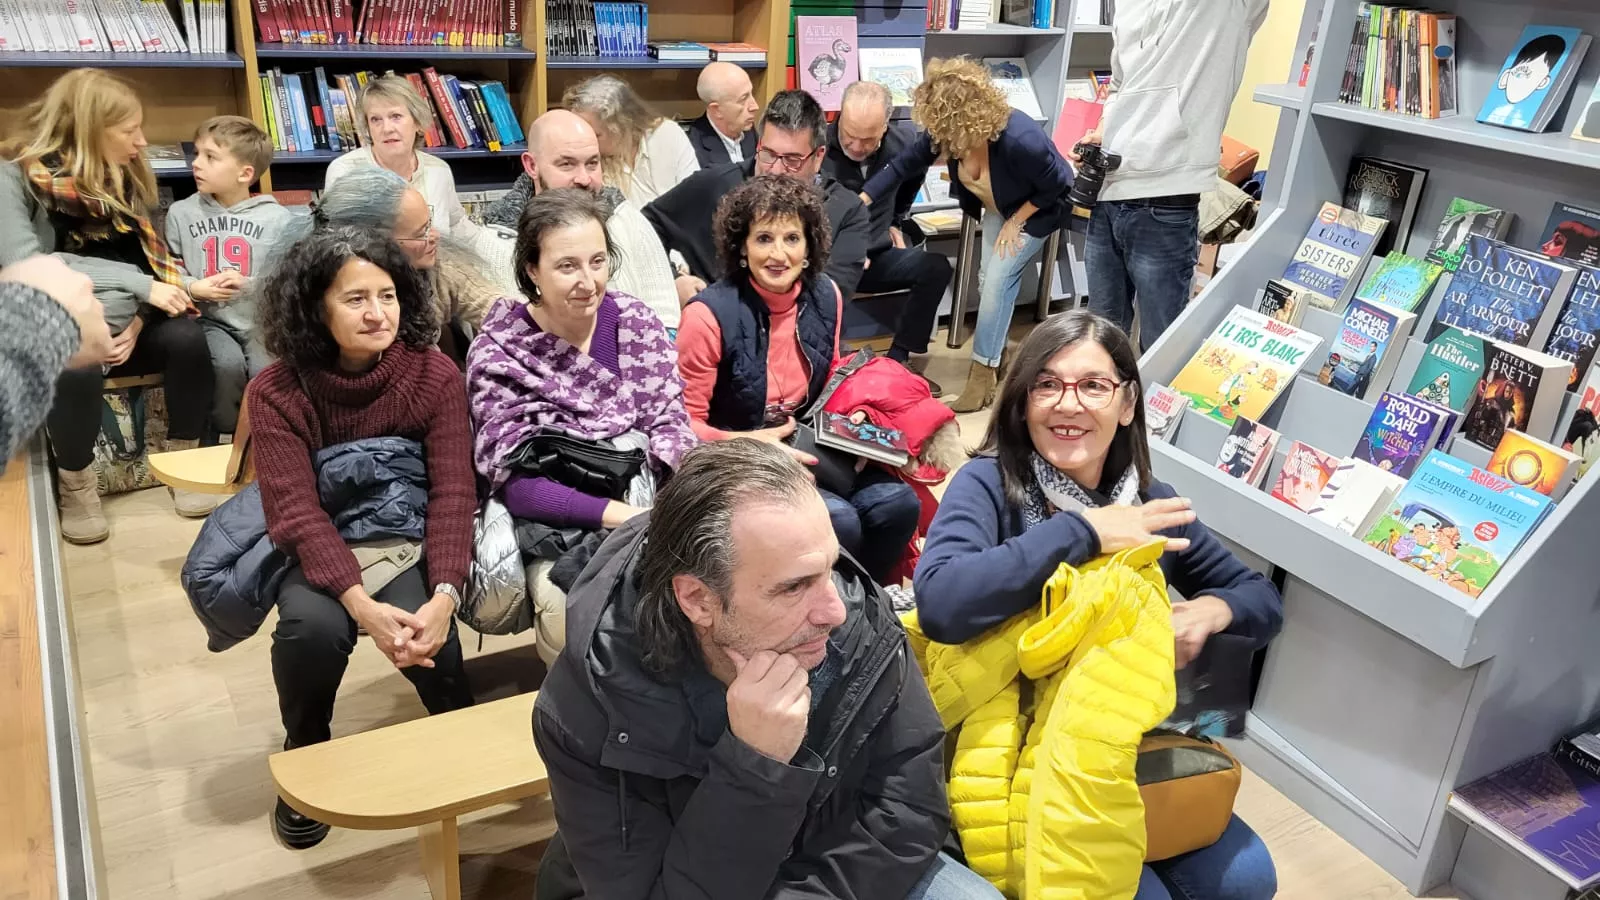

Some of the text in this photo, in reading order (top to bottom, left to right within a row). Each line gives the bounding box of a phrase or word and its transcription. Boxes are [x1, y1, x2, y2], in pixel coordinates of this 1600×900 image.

[805, 25, 844, 37] ATLAS
[1358, 162, 1399, 187] PATRICK
[189, 216, 264, 240] CHAMPION
[1318, 226, 1360, 250] three
[202, 236, 254, 279] 19
[1301, 244, 1353, 273] SISTERS
[1504, 257, 1539, 280] KEN
[1298, 274, 1328, 291] MORRIS
[1300, 268, 1333, 285] HEATHER
[1480, 266, 1551, 303] FOLLETT
[1577, 271, 1600, 290] EN
[1490, 296, 1515, 314] The
[1345, 316, 1390, 343] CONNELLY
[1351, 307, 1389, 331] MICHAEL
[1466, 303, 1530, 336] ARMOUR
[1260, 338, 1306, 365] BLANC
[1430, 343, 1480, 372] Hustler
[1446, 342, 1463, 356] The
[1500, 351, 1525, 369] PETER
[1490, 358, 1538, 387] BRETT
[1386, 397, 1430, 425] ROALD
[1382, 411, 1419, 438] DAHL
[1377, 427, 1412, 451] WITCHES
[1421, 472, 1469, 498] L'EMPIRE
[1468, 493, 1486, 505] DU
[1485, 501, 1527, 524] MILIEU
